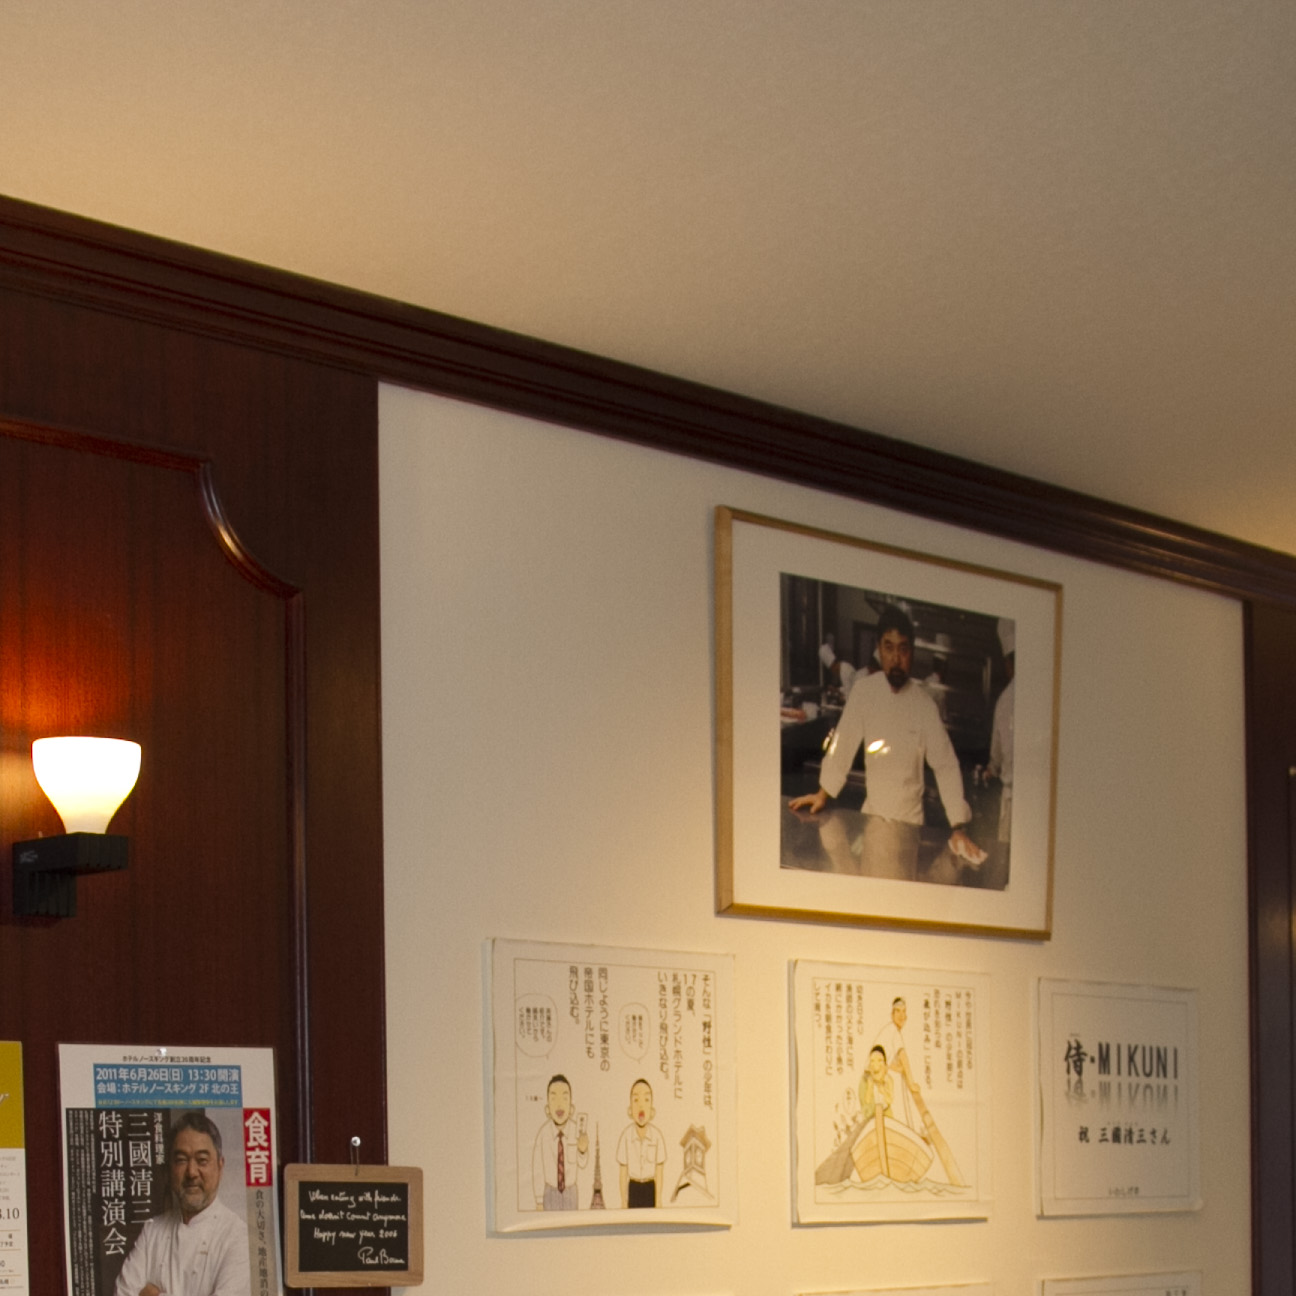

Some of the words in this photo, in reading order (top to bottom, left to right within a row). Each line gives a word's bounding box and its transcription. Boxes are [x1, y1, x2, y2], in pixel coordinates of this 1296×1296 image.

[211, 1083, 240, 1095] 北の王
[1079, 1125, 1090, 1143] 祝
[245, 1111, 270, 1185] 食育
[127, 1112, 154, 1225] 三國清三
[98, 1110, 128, 1256] 特別講演会
[358, 1191, 373, 1202] with
[313, 1227, 336, 1245] Happy
